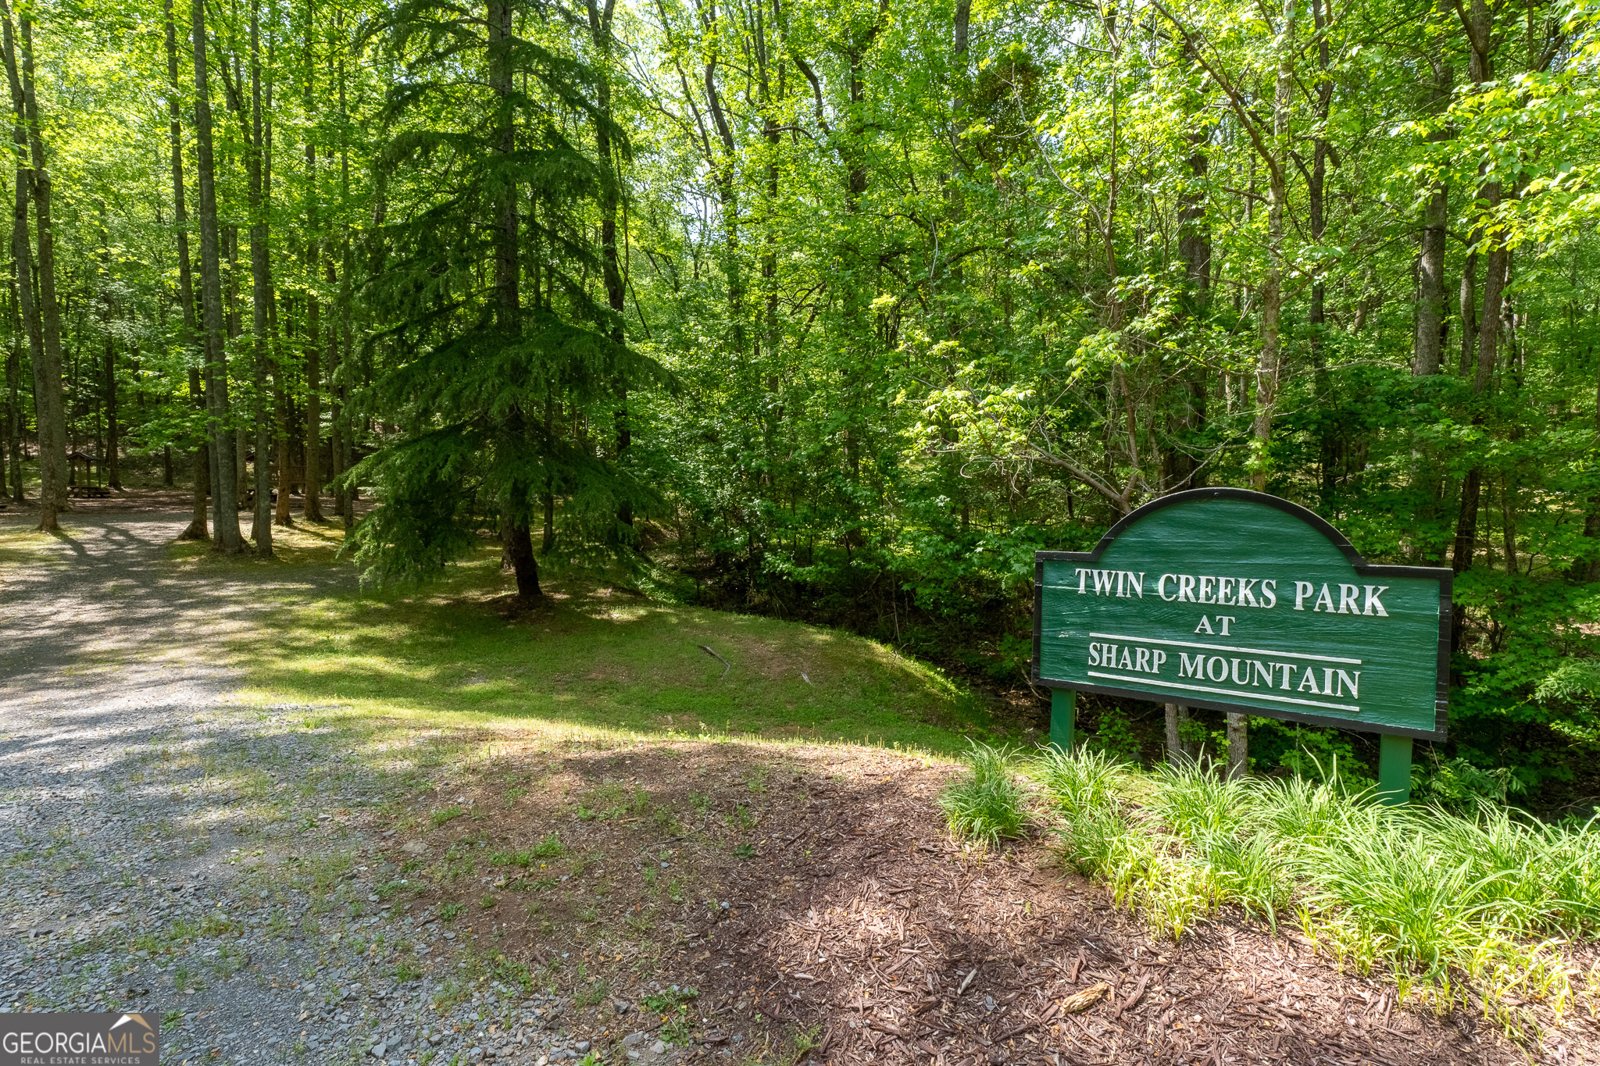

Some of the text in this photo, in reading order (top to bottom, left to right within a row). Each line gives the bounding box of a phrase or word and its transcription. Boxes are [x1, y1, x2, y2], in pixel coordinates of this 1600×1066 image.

[1075, 568, 1390, 617] TWIN CREEKS PARK
[1194, 615, 1236, 636] AT
[1088, 642, 1361, 699] SHARP MOUNTAIN
